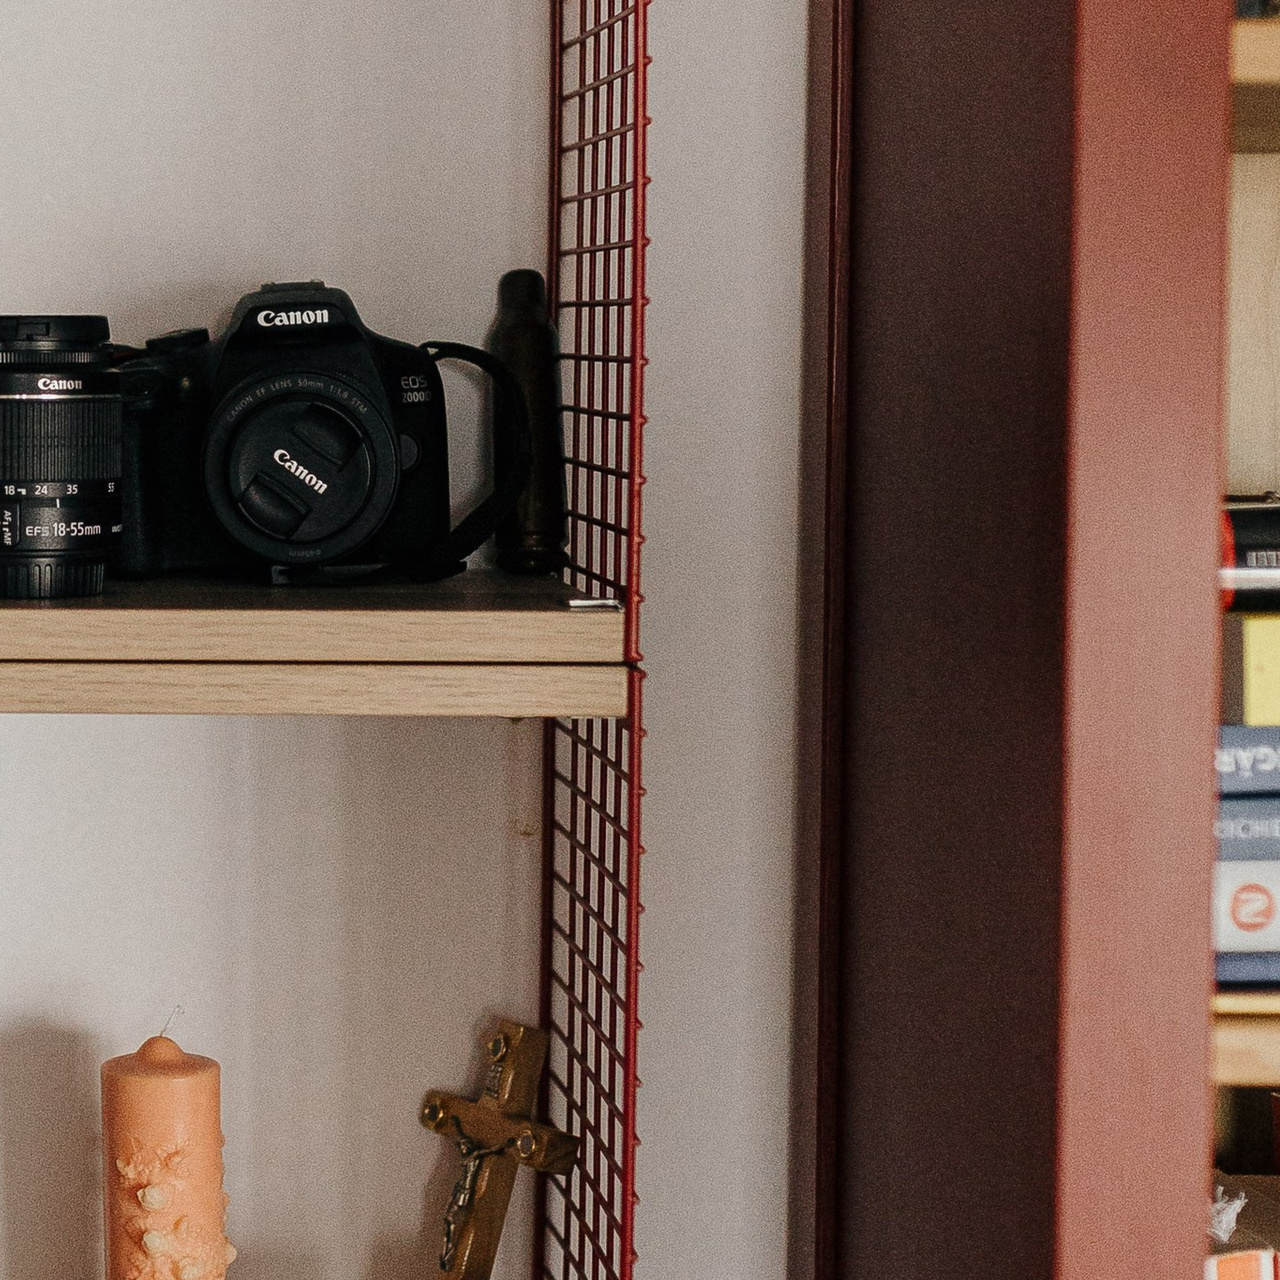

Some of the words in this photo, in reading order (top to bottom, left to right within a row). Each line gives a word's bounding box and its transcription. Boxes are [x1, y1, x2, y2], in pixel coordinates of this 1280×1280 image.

[257, 308, 329, 327] Canon
[37, 377, 83, 391] Canon
[400, 375, 428, 389] EOS
[226, 394, 254, 422] CANON
[255, 386, 266, 397] EF
[270, 379, 293, 391] LENS
[297, 378, 324, 389] 50mm
[401, 390, 432, 403] 2000D
[273, 448, 329, 495] Canon
[4, 485, 16, 495] 18
[35, 485, 48, 495] 24
[66, 484, 78, 494] 35
[107, 482, 116, 492] 55
[3, 509, 12, 522] AF
[52, 521, 102, 537] 18-55mm
[3, 532, 12, 546] MF
